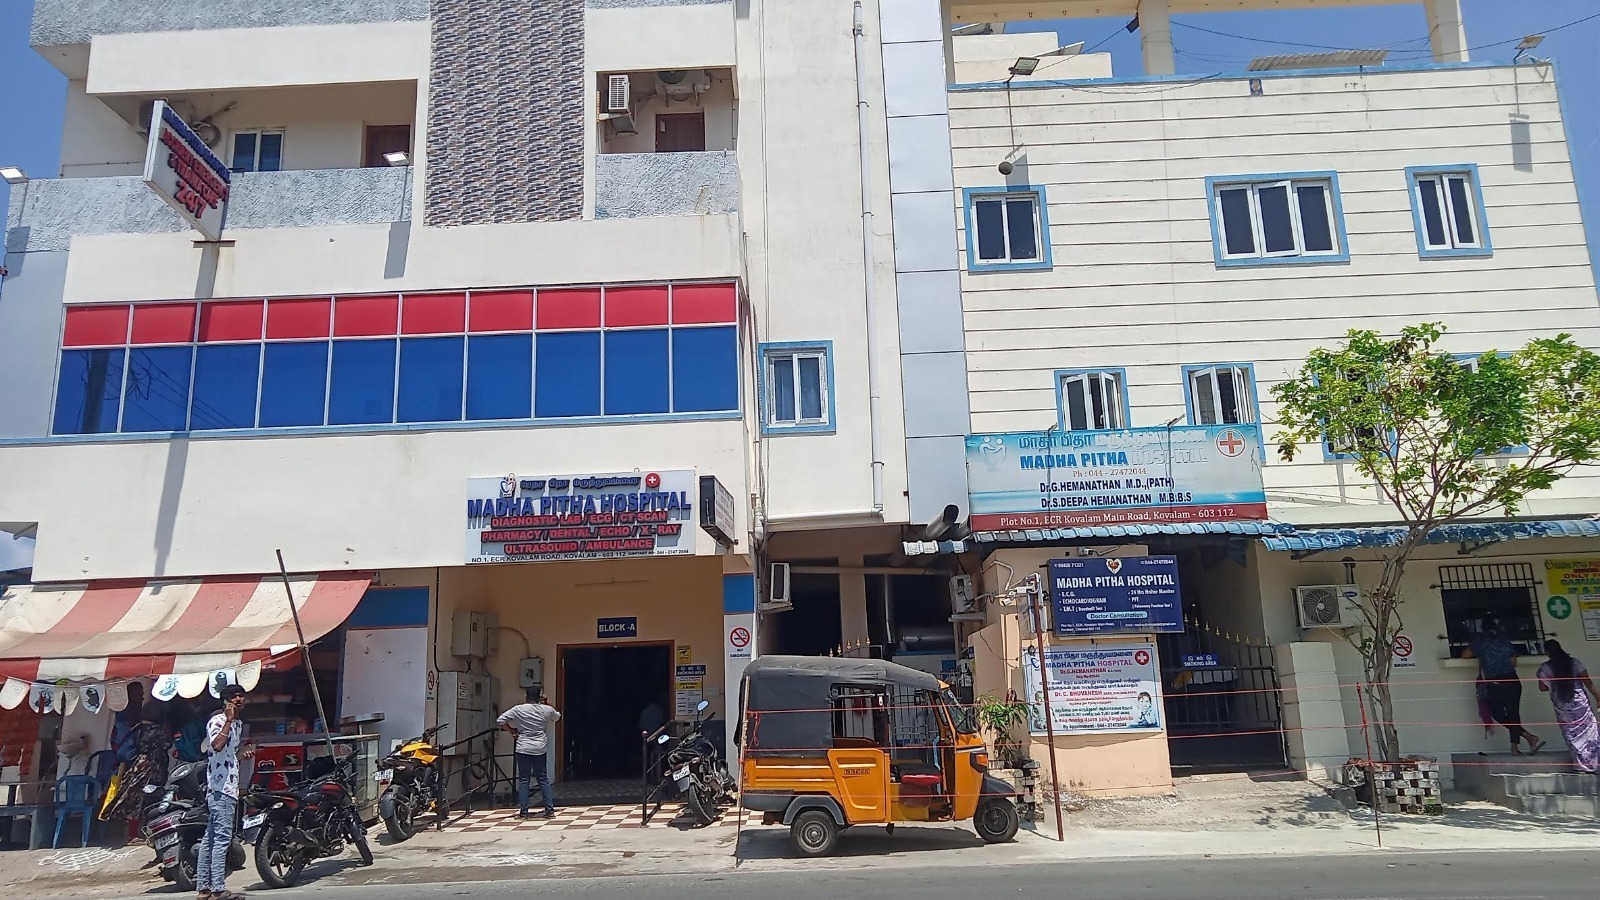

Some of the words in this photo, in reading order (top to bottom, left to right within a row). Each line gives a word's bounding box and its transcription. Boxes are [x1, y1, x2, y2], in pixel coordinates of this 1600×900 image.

[175, 180, 206, 219] 24/7
[1020, 453, 1077, 469] MADHA
[1080, 451, 1129, 467] PITHA
[1088, 469, 1103, 477] 044
[1110, 468, 1147, 476] 27472044
[1040, 479, 1120, 493] Dr.G.HEMANATHAN
[467, 496, 535, 518] MADHA
[540, 494, 597, 515] PITHA
[601, 491, 692, 513] HOSPITAL
[1041, 495, 1088, 508] Dr.S.DEEPA
[1090, 493, 1151, 507] HEMANATHAN
[491, 515, 557, 528] DIAGNOSTIC
[560, 513, 582, 524] LAB
[590, 513, 612, 524] ECG
[619, 512, 635, 523] CT
[637, 511, 667, 522] SCAN
[1000, 517, 1018, 526] Plot
[1020, 516, 1042, 526] No.1,
[1044, 515, 1062, 524] ECR
[1064, 514, 1101, 524] Kovalam
[1103, 513, 1125, 521] Main
[1127, 511, 1151, 521] Road,
[1153, 510, 1191, 519] Kovalam
[1198, 509, 1214, 518] 603
[1217, 508, 1237, 517] 112.
[482, 530, 542, 542] PHARMACY
[550, 527, 591, 539] DENTAL
[601, 525, 630, 537] ECHO
[641, 524, 649, 536] X
[657, 523, 679, 534] RAY
[505, 541, 578, 554] ULTRASOUND
[586, 538, 653, 550] AMBULANCE
[506, 554, 540, 562] KOVALAM
[1056, 577, 1093, 588] MADHA
[1095, 576, 1125, 587] PITHA
[1127, 574, 1175, 586] HOSPITAL
[599, 623, 625, 632] BLOCK
